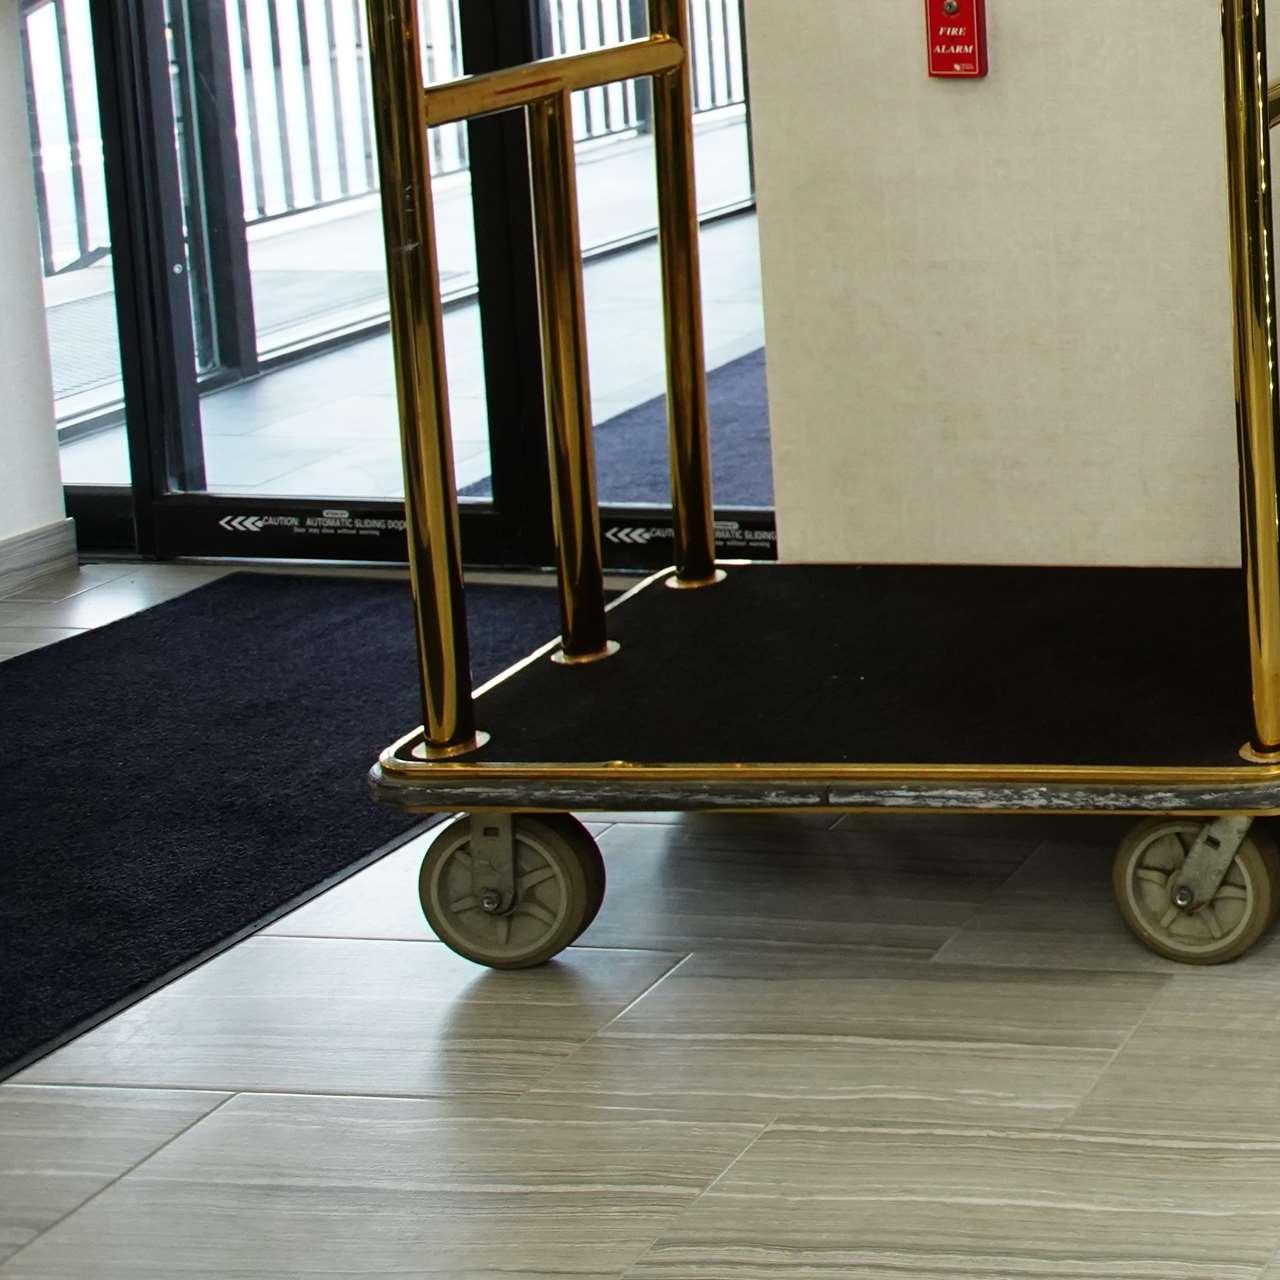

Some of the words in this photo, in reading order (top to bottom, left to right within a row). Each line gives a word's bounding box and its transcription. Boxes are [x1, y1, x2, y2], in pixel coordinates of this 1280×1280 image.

[939, 26, 966, 36] FIRE
[934, 44, 974, 54] ALARM
[305, 517, 353, 527] AUTOMATIC
[354, 519, 386, 529] SLIDING
[387, 520, 406, 530] DOO
